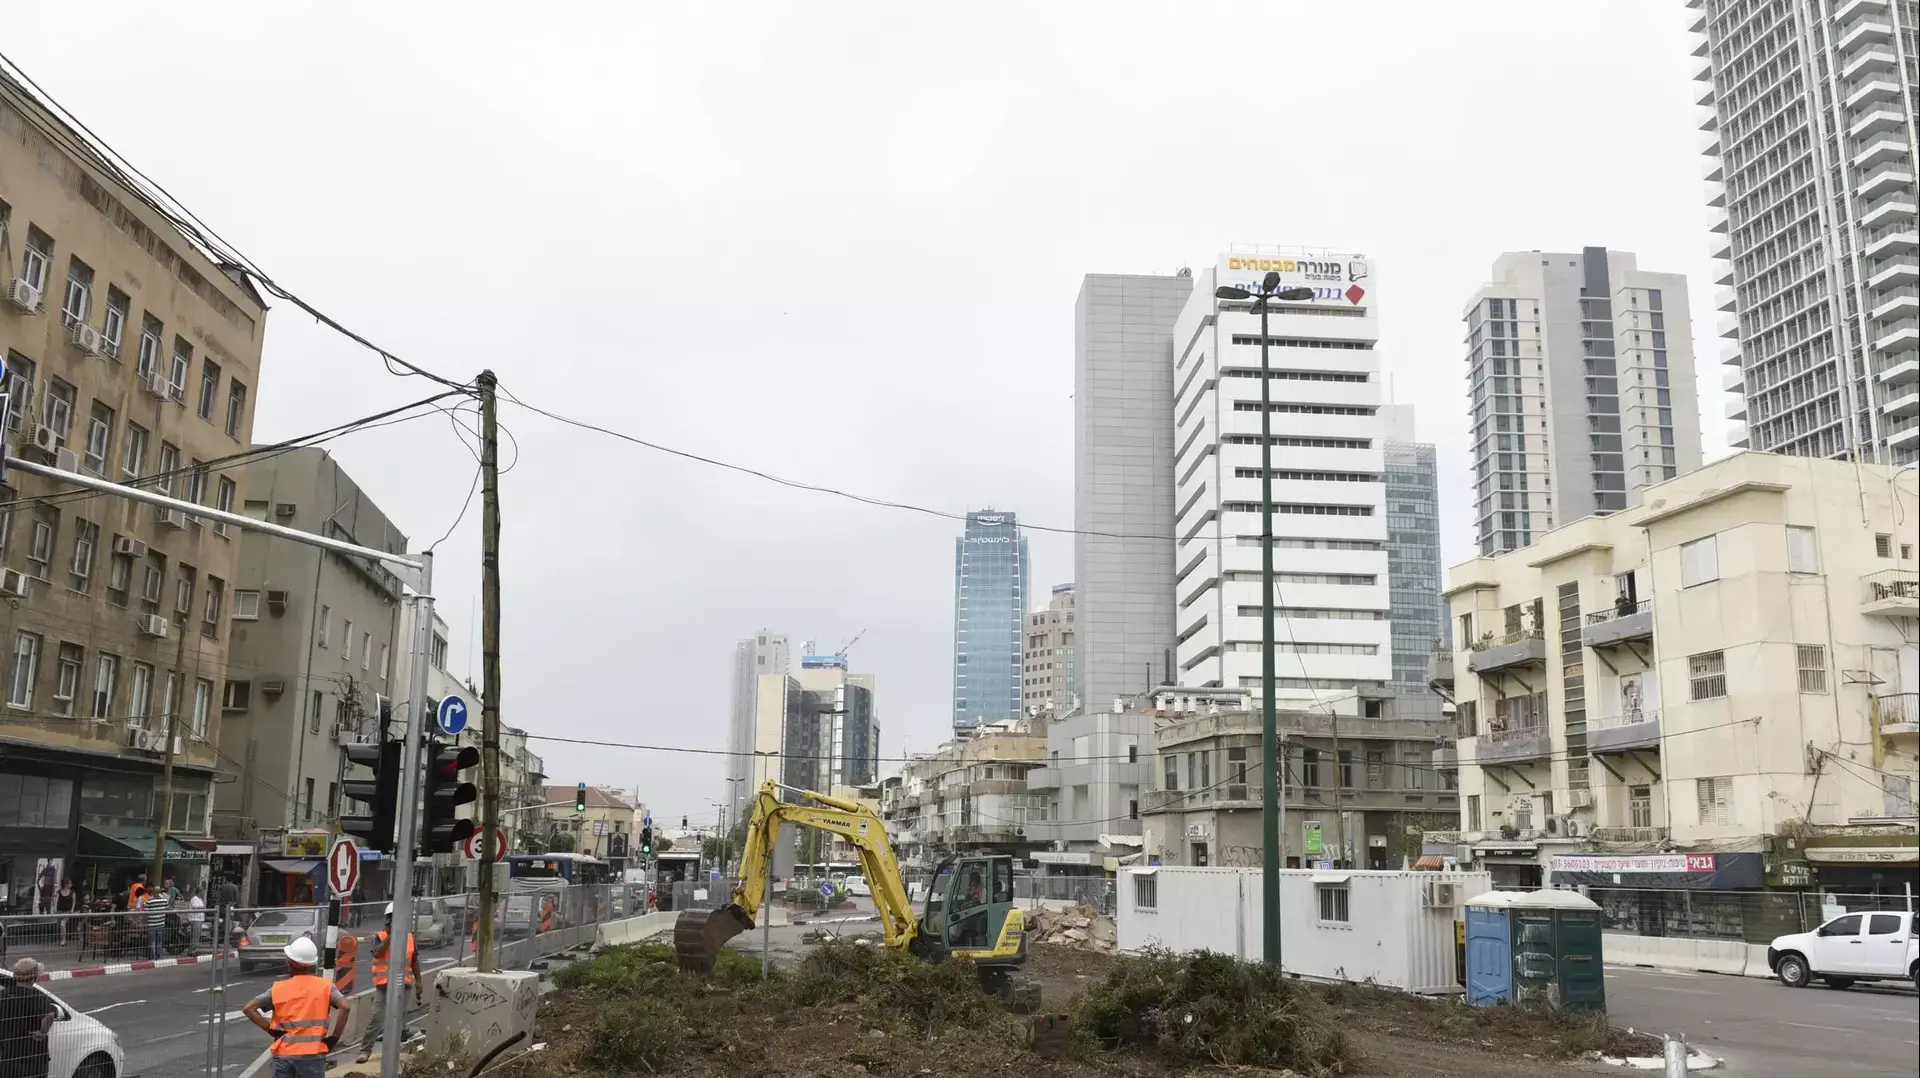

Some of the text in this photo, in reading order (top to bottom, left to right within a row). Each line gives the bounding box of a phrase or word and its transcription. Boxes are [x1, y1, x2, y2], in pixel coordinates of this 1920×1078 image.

[1229, 257, 1341, 274] מנורה מבטחים
[823, 818, 851, 827] YANMAR
[1688, 856, 1713, 869] גבאי
